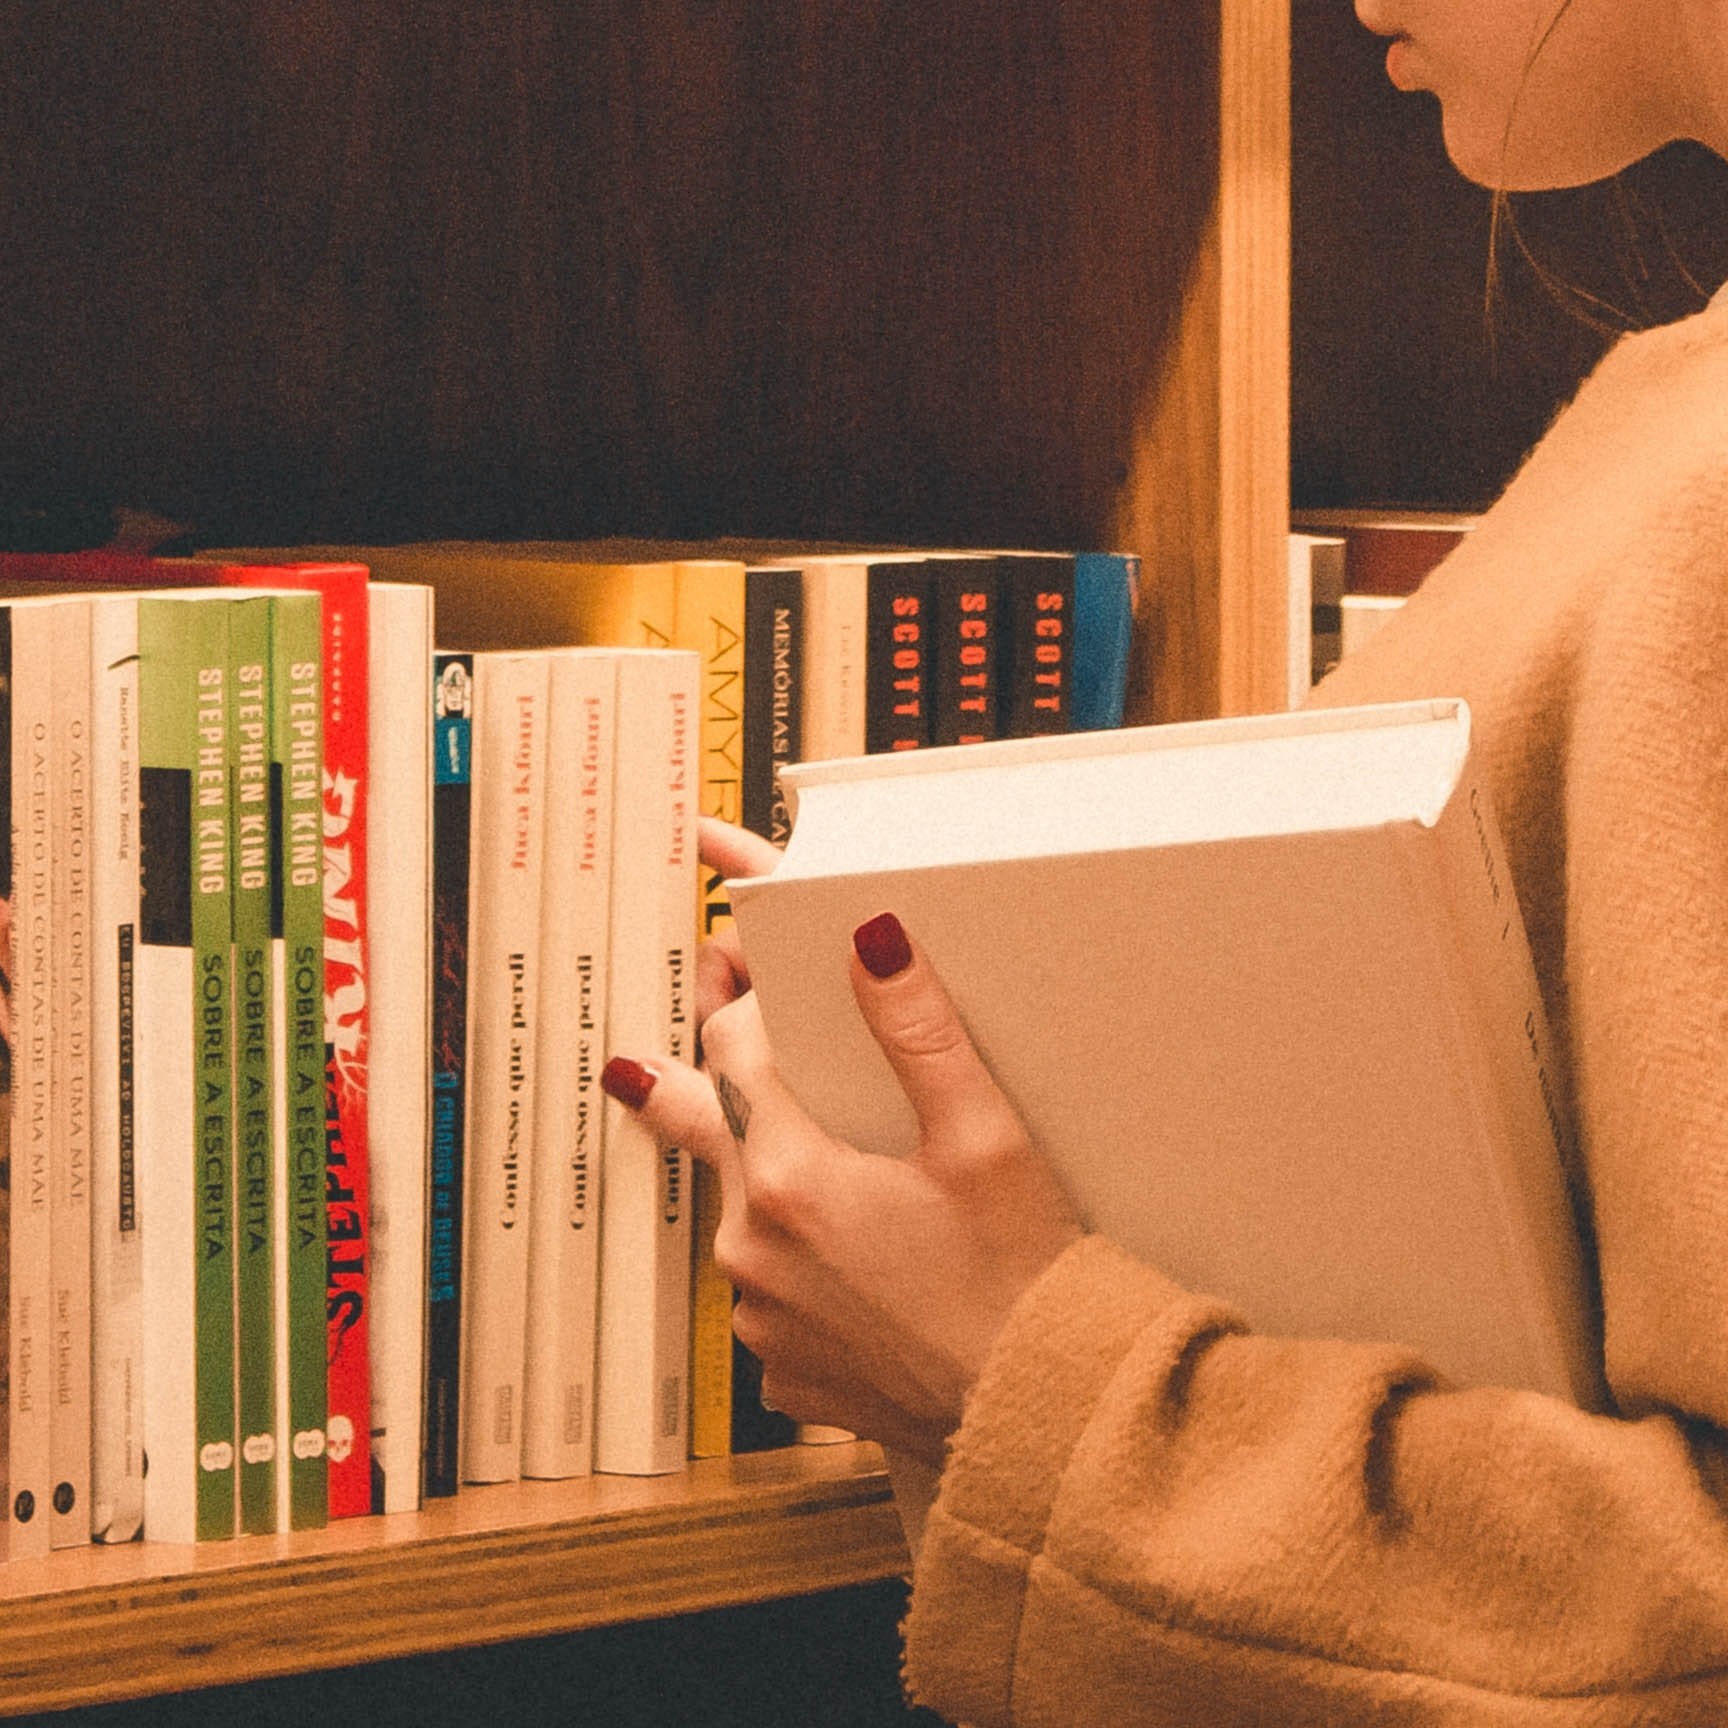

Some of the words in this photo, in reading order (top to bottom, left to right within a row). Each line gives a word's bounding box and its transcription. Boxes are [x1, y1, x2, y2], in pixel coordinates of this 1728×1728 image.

[772, 608, 793, 754] MEMÓRIAS
[892, 596, 920, 714] SCOTT
[959, 593, 986, 712] SCOTT
[1035, 592, 1063, 709] SCOTT
[198, 668, 221, 805] STEPHEN
[239, 665, 262, 802] STEPHEN
[292, 662, 315, 798] STEPHEN
[199, 819, 222, 893] KING
[240, 815, 263, 889] KING
[292, 812, 315, 886] KING
[204, 954, 221, 1066] SOBRE
[245, 951, 262, 1063] SOBRE
[295, 946, 313, 1059] SOBRE
[204, 1083, 221, 1102] A
[245, 1075, 262, 1096] A
[295, 1071, 313, 1092] A
[204, 1115, 222, 1258] ESCRITA
[245, 1112, 263, 1253] ESCRITA
[295, 1107, 314, 1248] ESCRITA
